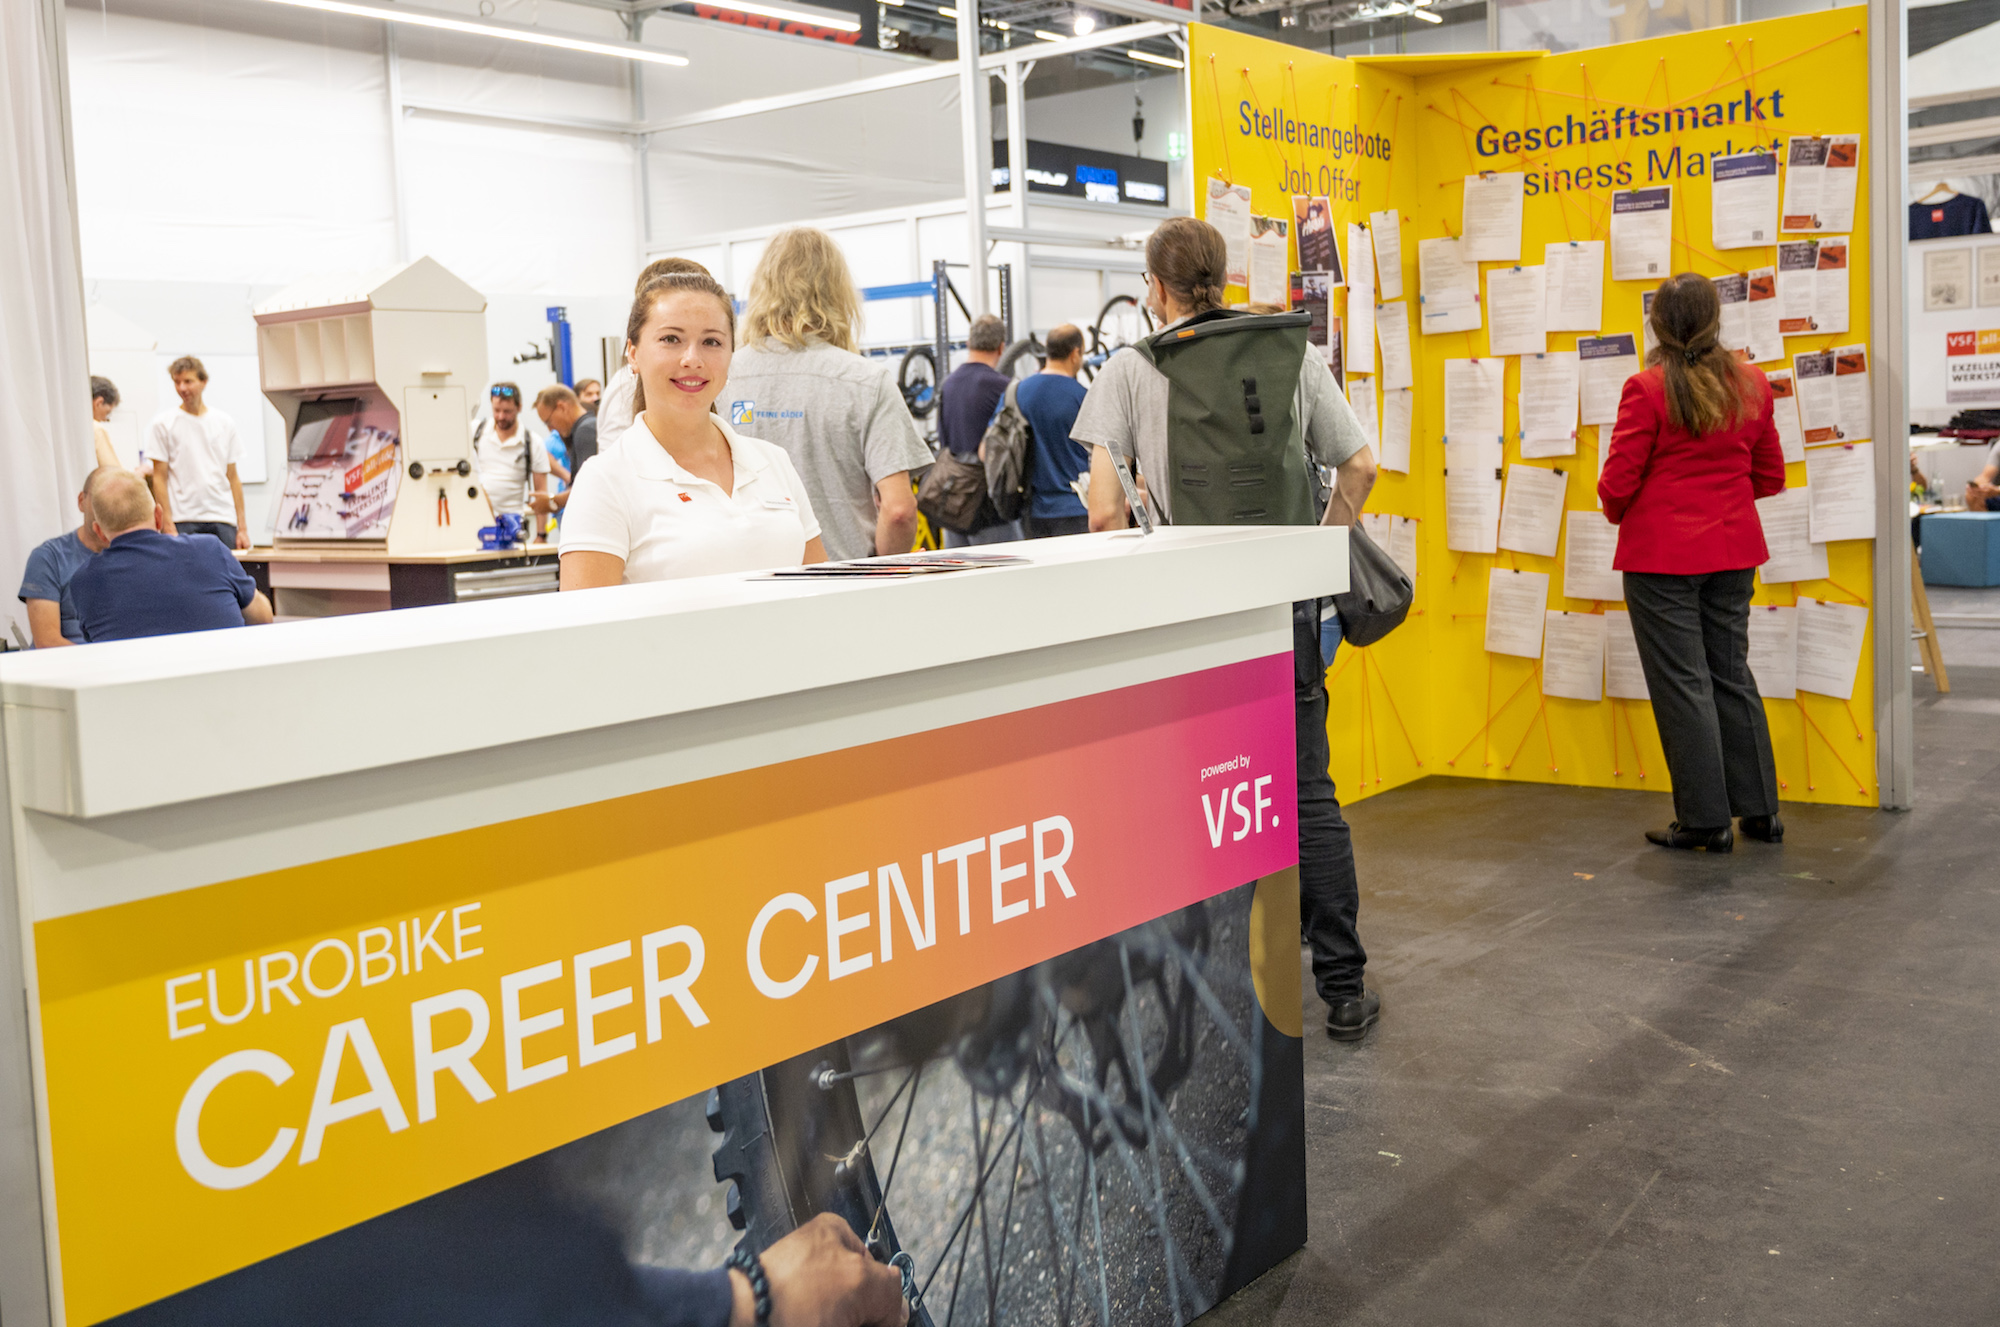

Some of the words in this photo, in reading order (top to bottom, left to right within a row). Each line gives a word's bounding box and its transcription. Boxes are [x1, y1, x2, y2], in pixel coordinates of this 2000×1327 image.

[1240, 100, 1391, 161] Stellenangebote
[1476, 89, 1785, 157] Geschäftsmarkt
[1279, 160, 1312, 194] Job
[1319, 165, 1361, 201] Offer
[1480, 160, 1633, 196] siness
[1201, 756, 1239, 782] powered
[1240, 754, 1251, 769] by
[1201, 774, 1280, 849] VSF.
[167, 902, 484, 1039] EUROBIKE
[176, 924, 710, 1190] CAREER
[746, 814, 1077, 999] CENTER
